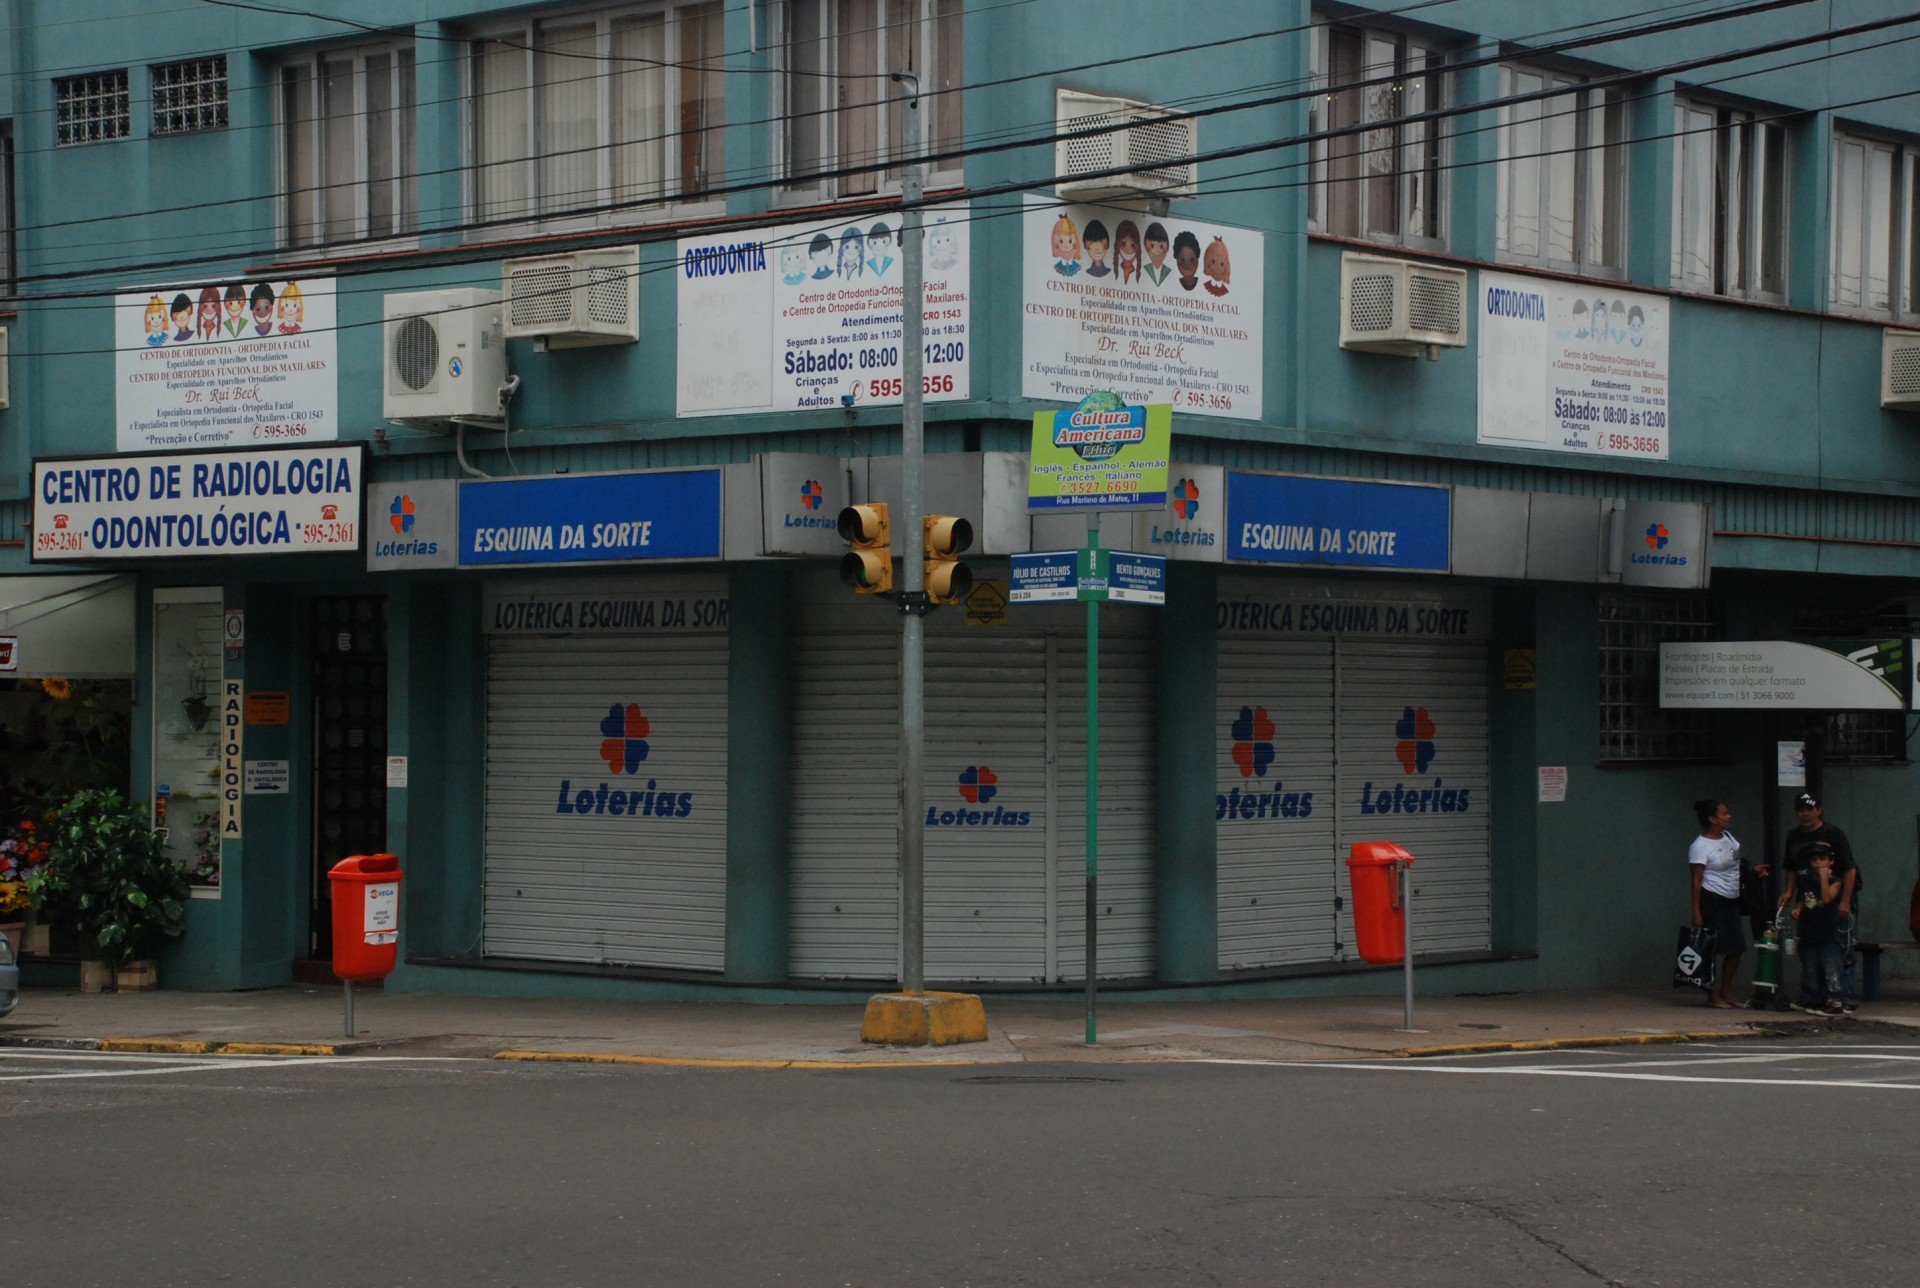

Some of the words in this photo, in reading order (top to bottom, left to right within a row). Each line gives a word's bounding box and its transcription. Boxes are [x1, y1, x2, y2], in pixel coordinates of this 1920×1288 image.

[685, 241, 766, 279] ORTODONTIA
[799, 290, 825, 304] Centro
[826, 288, 836, 301] de
[838, 286, 904, 300] Ortodontia-Ortop
[923, 282, 948, 292] Facial
[1046, 280, 1084, 295] CENTRO
[1085, 286, 1097, 296] DE
[1099, 287, 1156, 304] ORTODONTIA
[1162, 296, 1209, 311] ORTOPEDIA
[1211, 302, 1240, 315] FACIAL
[790, 306, 815, 316] Centro
[816, 304, 826, 314] de
[828, 300, 866, 314] Ortopedia
[868, 298, 904, 310] Funciona
[1488, 287, 1545, 322] ORTODONTIA
[923, 312, 940, 321] CRO
[943, 309, 961, 319] 1543
[1026, 303, 1064, 317] CENTRO
[1065, 308, 1078, 319] DE
[1080, 310, 1130, 325] ORTOPEDIA
[1132, 316, 1181, 332] FUNCIONAL
[1182, 322, 1199, 334] DOS
[1201, 325, 1248, 340] MAXILARES
[786, 337, 818, 348] Segunda
[827, 332, 851, 344] Sexta:
[852, 331, 868, 342] 8:00
[880, 329, 902, 340] 11:30
[943, 324, 965, 335] 18:30
[140, 350, 170, 361] CENTRO
[172, 349, 182, 358] DE
[183, 345, 232, 357] ORTODONTIA
[238, 342, 282, 353] ORTOPEDIA
[283, 339, 312, 350] FACIAL
[784, 348, 853, 375] Sábado:
[859, 347, 898, 369] 08:00
[924, 342, 964, 364] 12:00
[1098, 337, 1118, 352] Dr.
[1129, 340, 1150, 359] Rui
[1156, 343, 1186, 364] Beck
[129, 372, 160, 383] CENTRO
[160, 371, 171, 380] DE
[172, 368, 215, 380] ORTOPEDIA
[217, 365, 261, 376] FUNCIONAL
[263, 364, 278, 373] DOS
[280, 360, 326, 372] MAXILARES
[1065, 352, 1106, 367] Especialista
[1108, 359, 1118, 367] em
[1120, 358, 1158, 372] Ortodontia
[1164, 363, 1197, 377] Ortopedia
[1199, 367, 1219, 378] Facial
[796, 376, 839, 388] Crianças
[870, 375, 954, 398] 595656
[1036, 363, 1079, 377] Especialista
[1092, 369, 1128, 382] Ortopedia
[1129, 373, 1164, 385] Funcional
[1166, 376, 1177, 387] dos
[1180, 378, 1211, 390] Maxilares
[1216, 382, 1233, 393] CRO
[1234, 384, 1250, 394] 1543
[1591, 379, 1631, 391] Atendimento
[186, 390, 202, 403] Dr.
[210, 388, 229, 404] Rui
[232, 386, 262, 402] Beck
[798, 396, 834, 407] Adultos
[1187, 392, 1232, 410] 595-3656
[1070, 410, 1130, 427] Cultura
[1554, 398, 1600, 421] Sábado:
[1604, 405, 1628, 424] 08:00
[1642, 410, 1665, 428] 12:00
[264, 424, 307, 438] 595-3656
[1056, 427, 1143, 443] Americana
[1562, 420, 1590, 432] Crianças
[1563, 438, 1588, 448] Adultos
[1609, 434, 1660, 452] 595-3656
[1034, 465, 1063, 474] Inglês
[1073, 462, 1119, 472] Espanhol
[1129, 460, 1166, 468] Alemão
[1056, 473, 1095, 482] Francês
[1105, 472, 1142, 480] Italiano
[42, 466, 140, 505] CENTRO
[150, 465, 181, 500] DE
[193, 458, 352, 498] RADIOLOGIA
[1072, 496, 1097, 504] Mariano
[92, 504, 291, 549] ODONTOLÓGICA
[784, 514, 836, 529] Loterias
[38, 532, 83, 551] 595-2361
[304, 522, 354, 544] 595-2361
[473, 526, 554, 552] ESQUINA
[560, 523, 586, 550] DA
[592, 520, 652, 548] SORTE
[1152, 526, 1216, 547] Loterias
[1241, 522, 1314, 551] ESQUINA
[1318, 528, 1343, 553] DA
[1347, 530, 1396, 556] SORTE
[374, 538, 438, 558] Loterias
[1631, 552, 1687, 566] Loterias
[1013, 567, 1028, 579] JÚLIO
[1030, 568, 1038, 577] DE
[1039, 566, 1070, 577] CASTILHOS
[1116, 564, 1132, 575] BENTO
[1133, 566, 1161, 578] GONÇALVES
[496, 595, 573, 628] LOTÉRICA
[579, 600, 655, 628] ESQUINA
[661, 600, 686, 627] DA
[692, 599, 728, 626] SOR
[1216, 594, 1292, 631] OTÉRICA
[1300, 604, 1378, 632] ESQUINA
[1385, 607, 1409, 633] DA
[1415, 608, 1469, 634] SORTE
[1665, 652, 1710, 662] Frontlights
[1665, 664, 1693, 673] Painéis
[1701, 664, 1727, 673] Placas
[1729, 664, 1740, 673] de
[1742, 664, 1774, 673] Estrada
[1665, 676, 1710, 686] Impressões
[1729, 676, 1767, 686] qualquer
[1770, 676, 1805, 685] formato
[1665, 691, 1734, 701] www.equipe3.com
[225, 683, 240, 832] RADIOLOGIA
[556, 778, 692, 818] Loterias
[1216, 780, 1313, 820] oterias
[1360, 778, 1470, 814] Loterias
[926, 805, 1030, 825] Loterias
